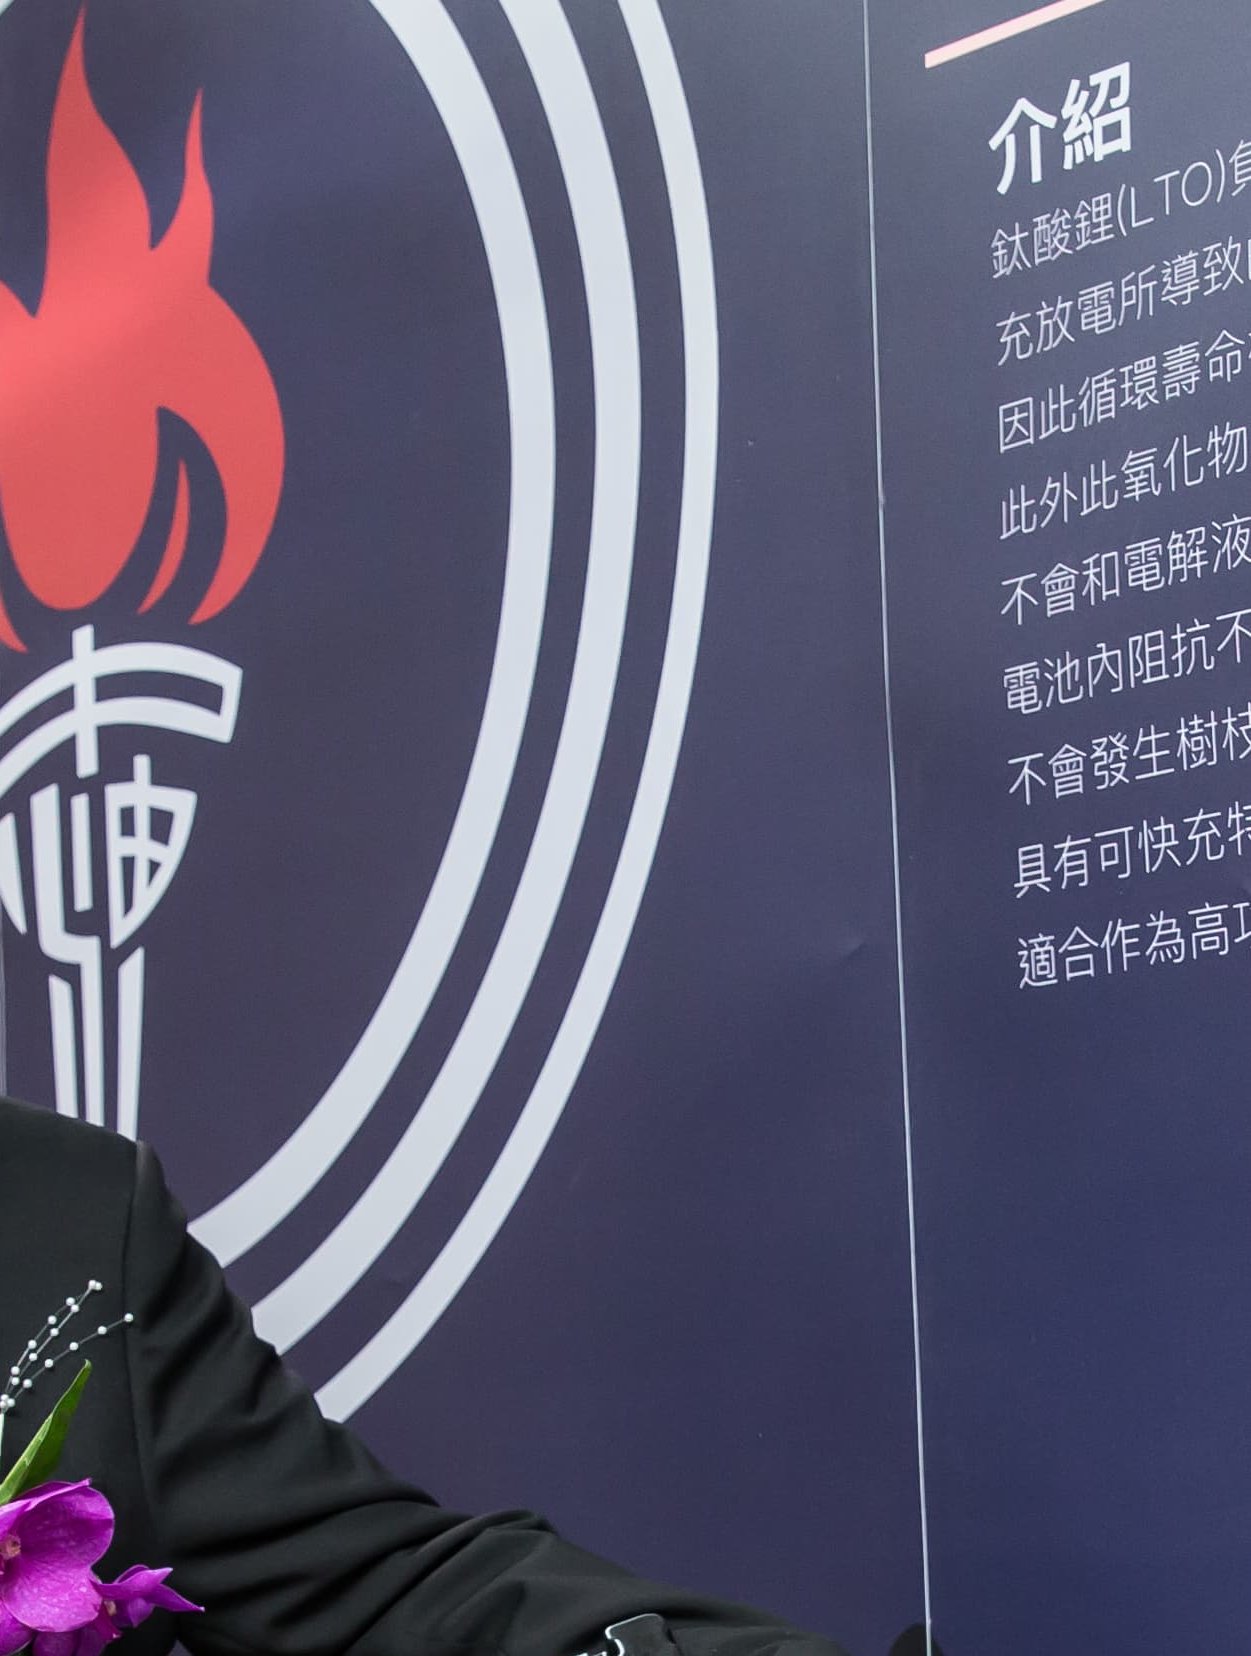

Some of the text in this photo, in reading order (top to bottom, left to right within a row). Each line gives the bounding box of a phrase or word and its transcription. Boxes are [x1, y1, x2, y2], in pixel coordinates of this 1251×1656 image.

[988, 61, 1132, 195] 介紹
[996, 236, 1251, 366] 充放電所導致
[999, 329, 1251, 453] 因此循環壽命
[1000, 421, 1248, 540] 此外此氧化物
[1000, 514, 1251, 625] 不會和電解液
[1003, 608, 1251, 715] 電池內阻抗不
[1008, 702, 1251, 805] 不會發生樹枝
